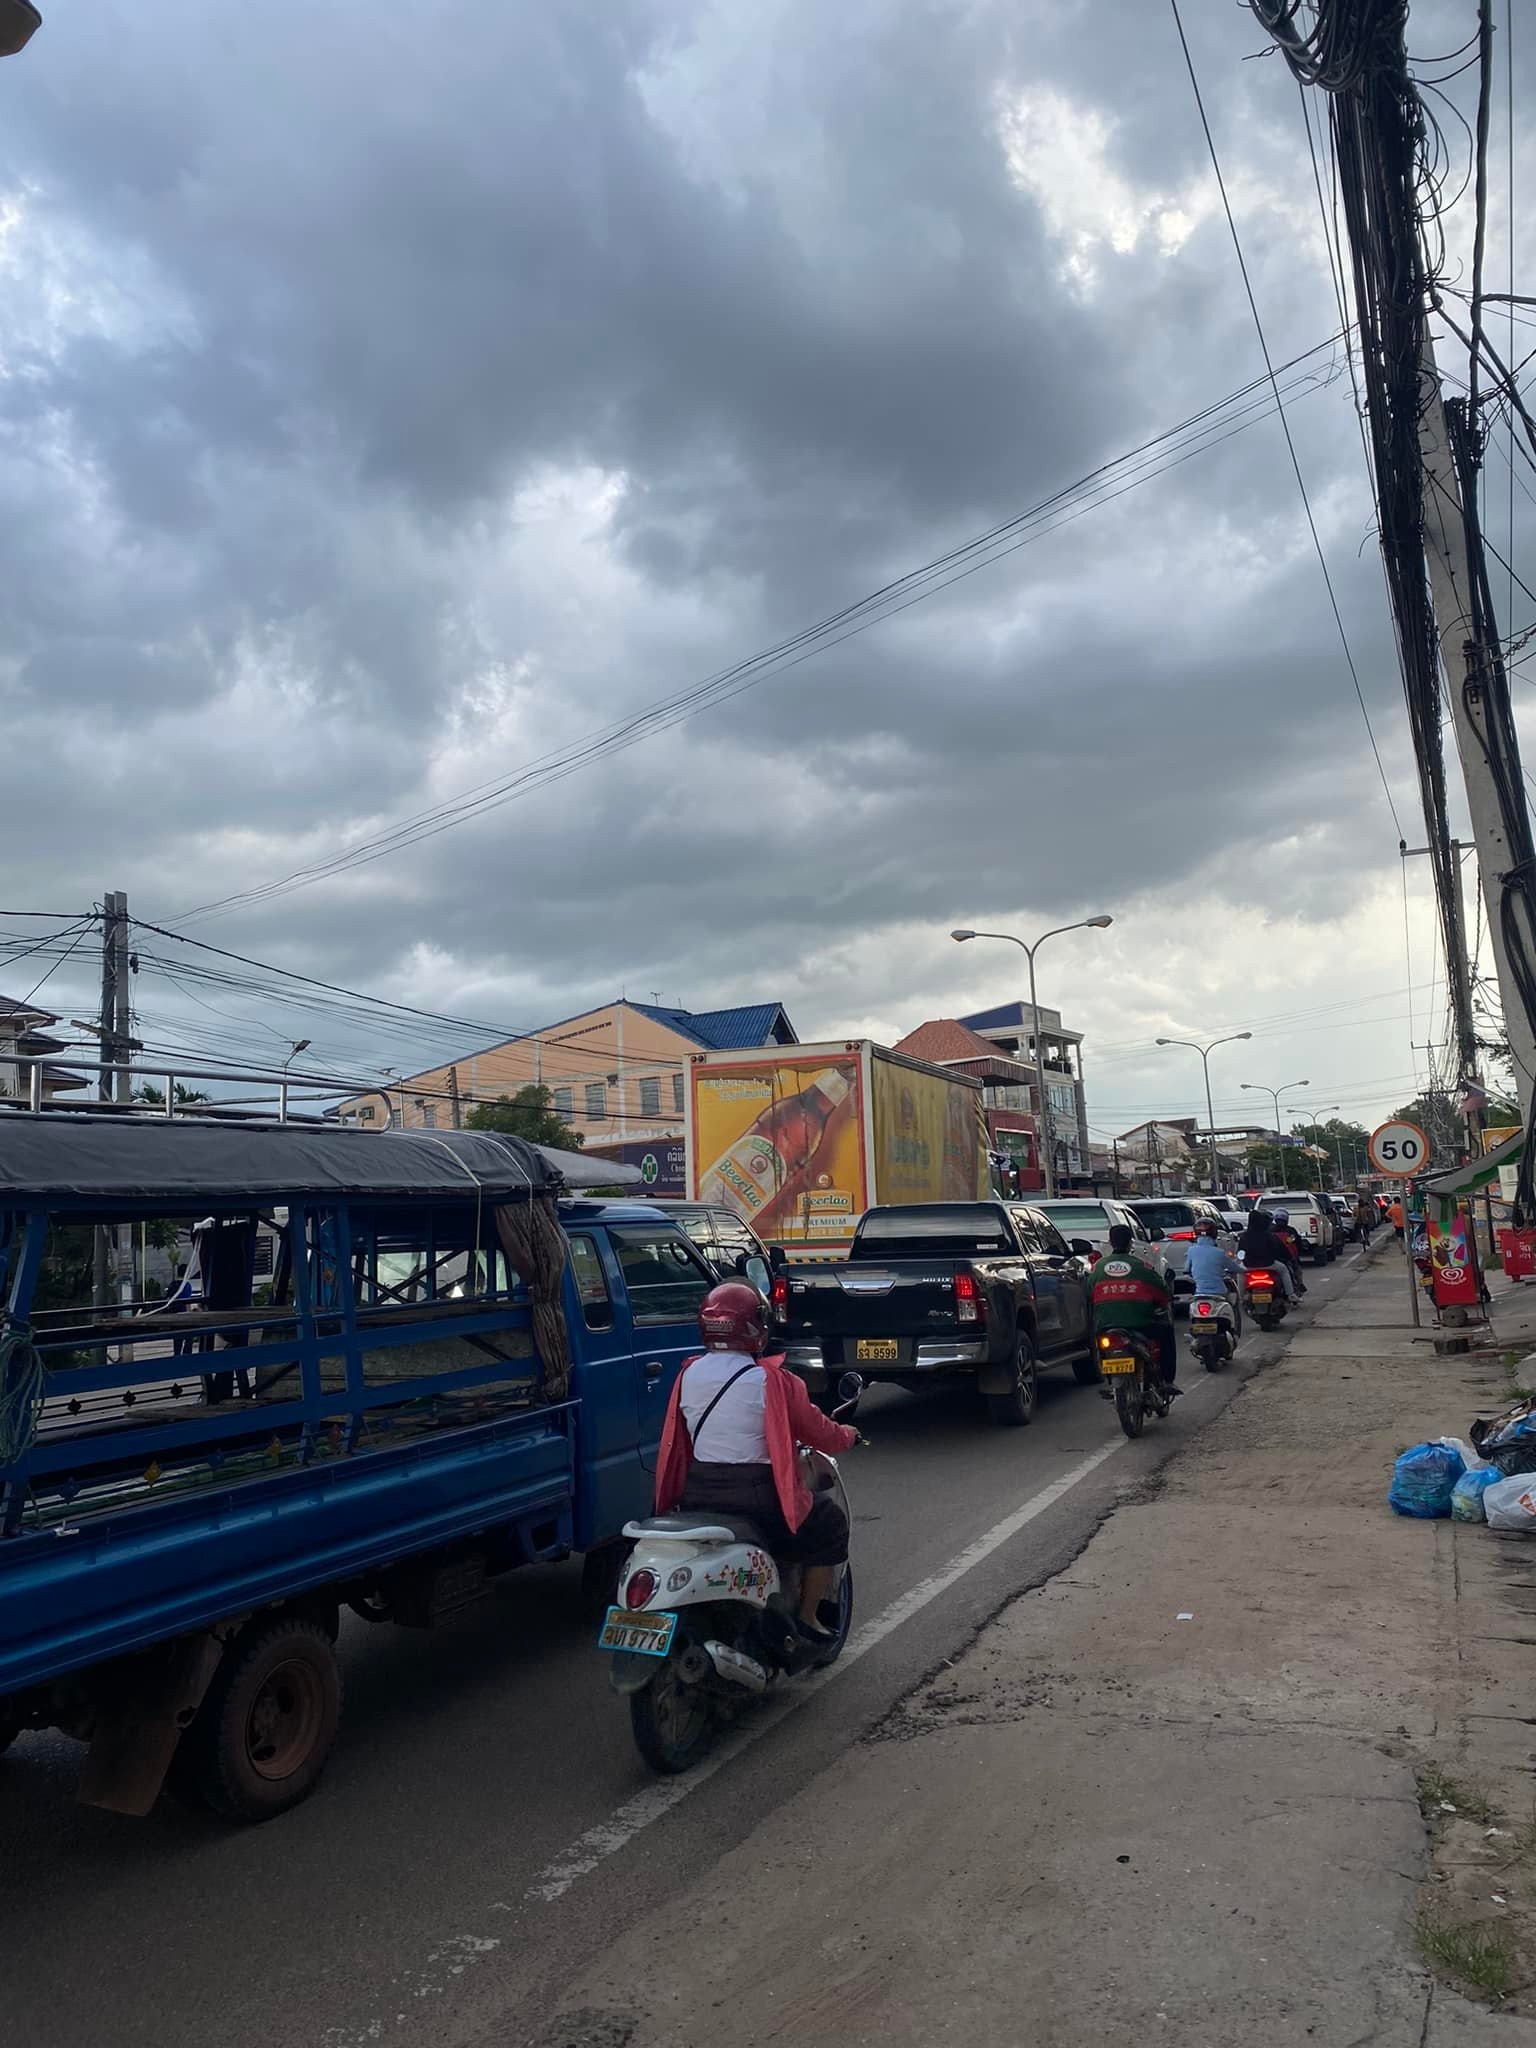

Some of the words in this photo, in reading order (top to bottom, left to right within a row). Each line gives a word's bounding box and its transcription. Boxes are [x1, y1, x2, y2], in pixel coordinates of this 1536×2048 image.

[1382, 1140, 1418, 1161] 50
[719, 1158, 762, 1208] Beerlao
[873, 1347, 897, 1359] 9599
[629, 1630, 668, 1651] 9779
